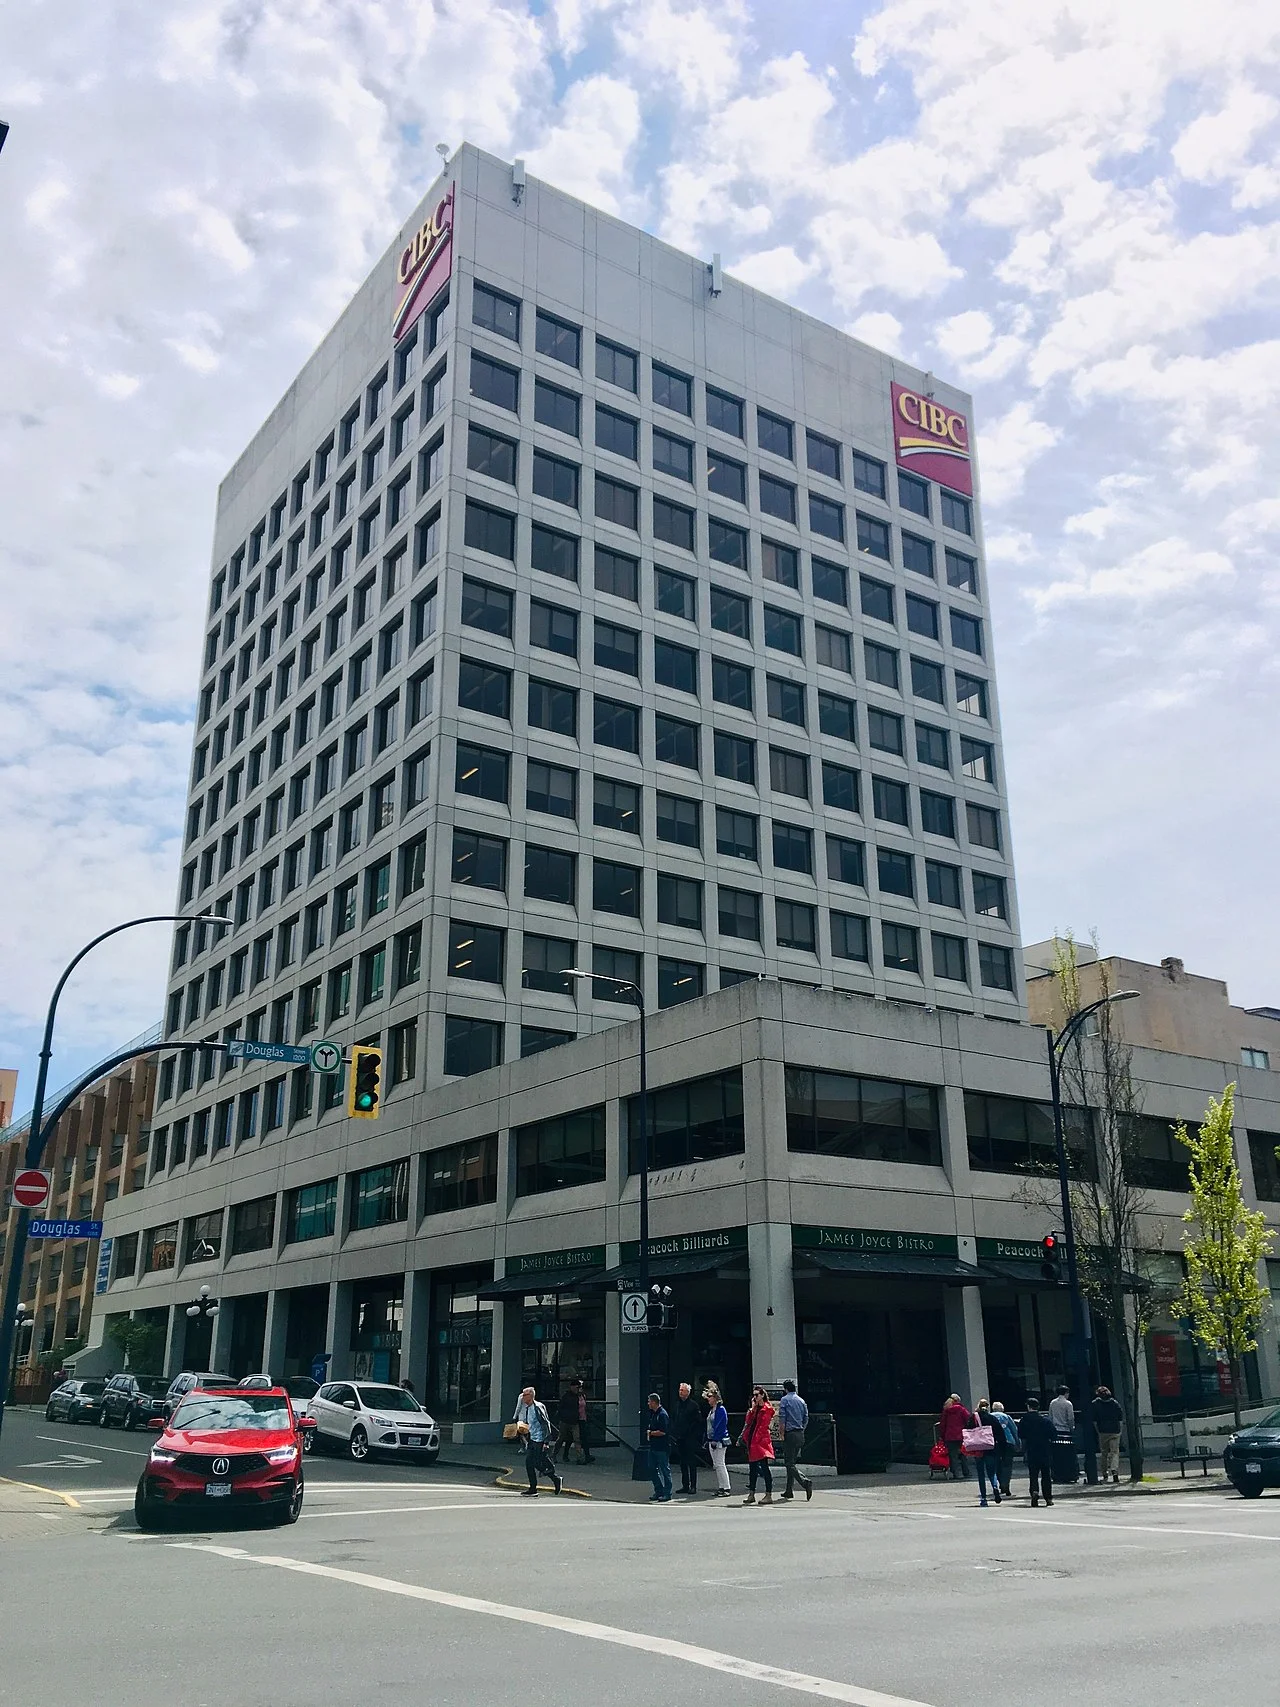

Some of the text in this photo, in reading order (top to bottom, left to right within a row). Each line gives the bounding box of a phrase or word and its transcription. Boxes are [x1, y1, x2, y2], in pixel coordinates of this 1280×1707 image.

[397, 193, 452, 285] CIBC
[898, 391, 967, 448] CIBC
[246, 1043, 284, 1058] Douglas
[32, 1221, 81, 1237] Douglas
[638, 1233, 730, 1257] acock Billiards
[819, 1229, 935, 1251] JAMES JOYCE BISTRO
[996, 1242, 1045, 1258] Peacock
[543, 1255, 564, 1269] JOYCE
[566, 1252, 592, 1265] BISTRO
[449, 1328, 471, 1344] IRIS
[546, 1322, 572, 1339] IRIS
